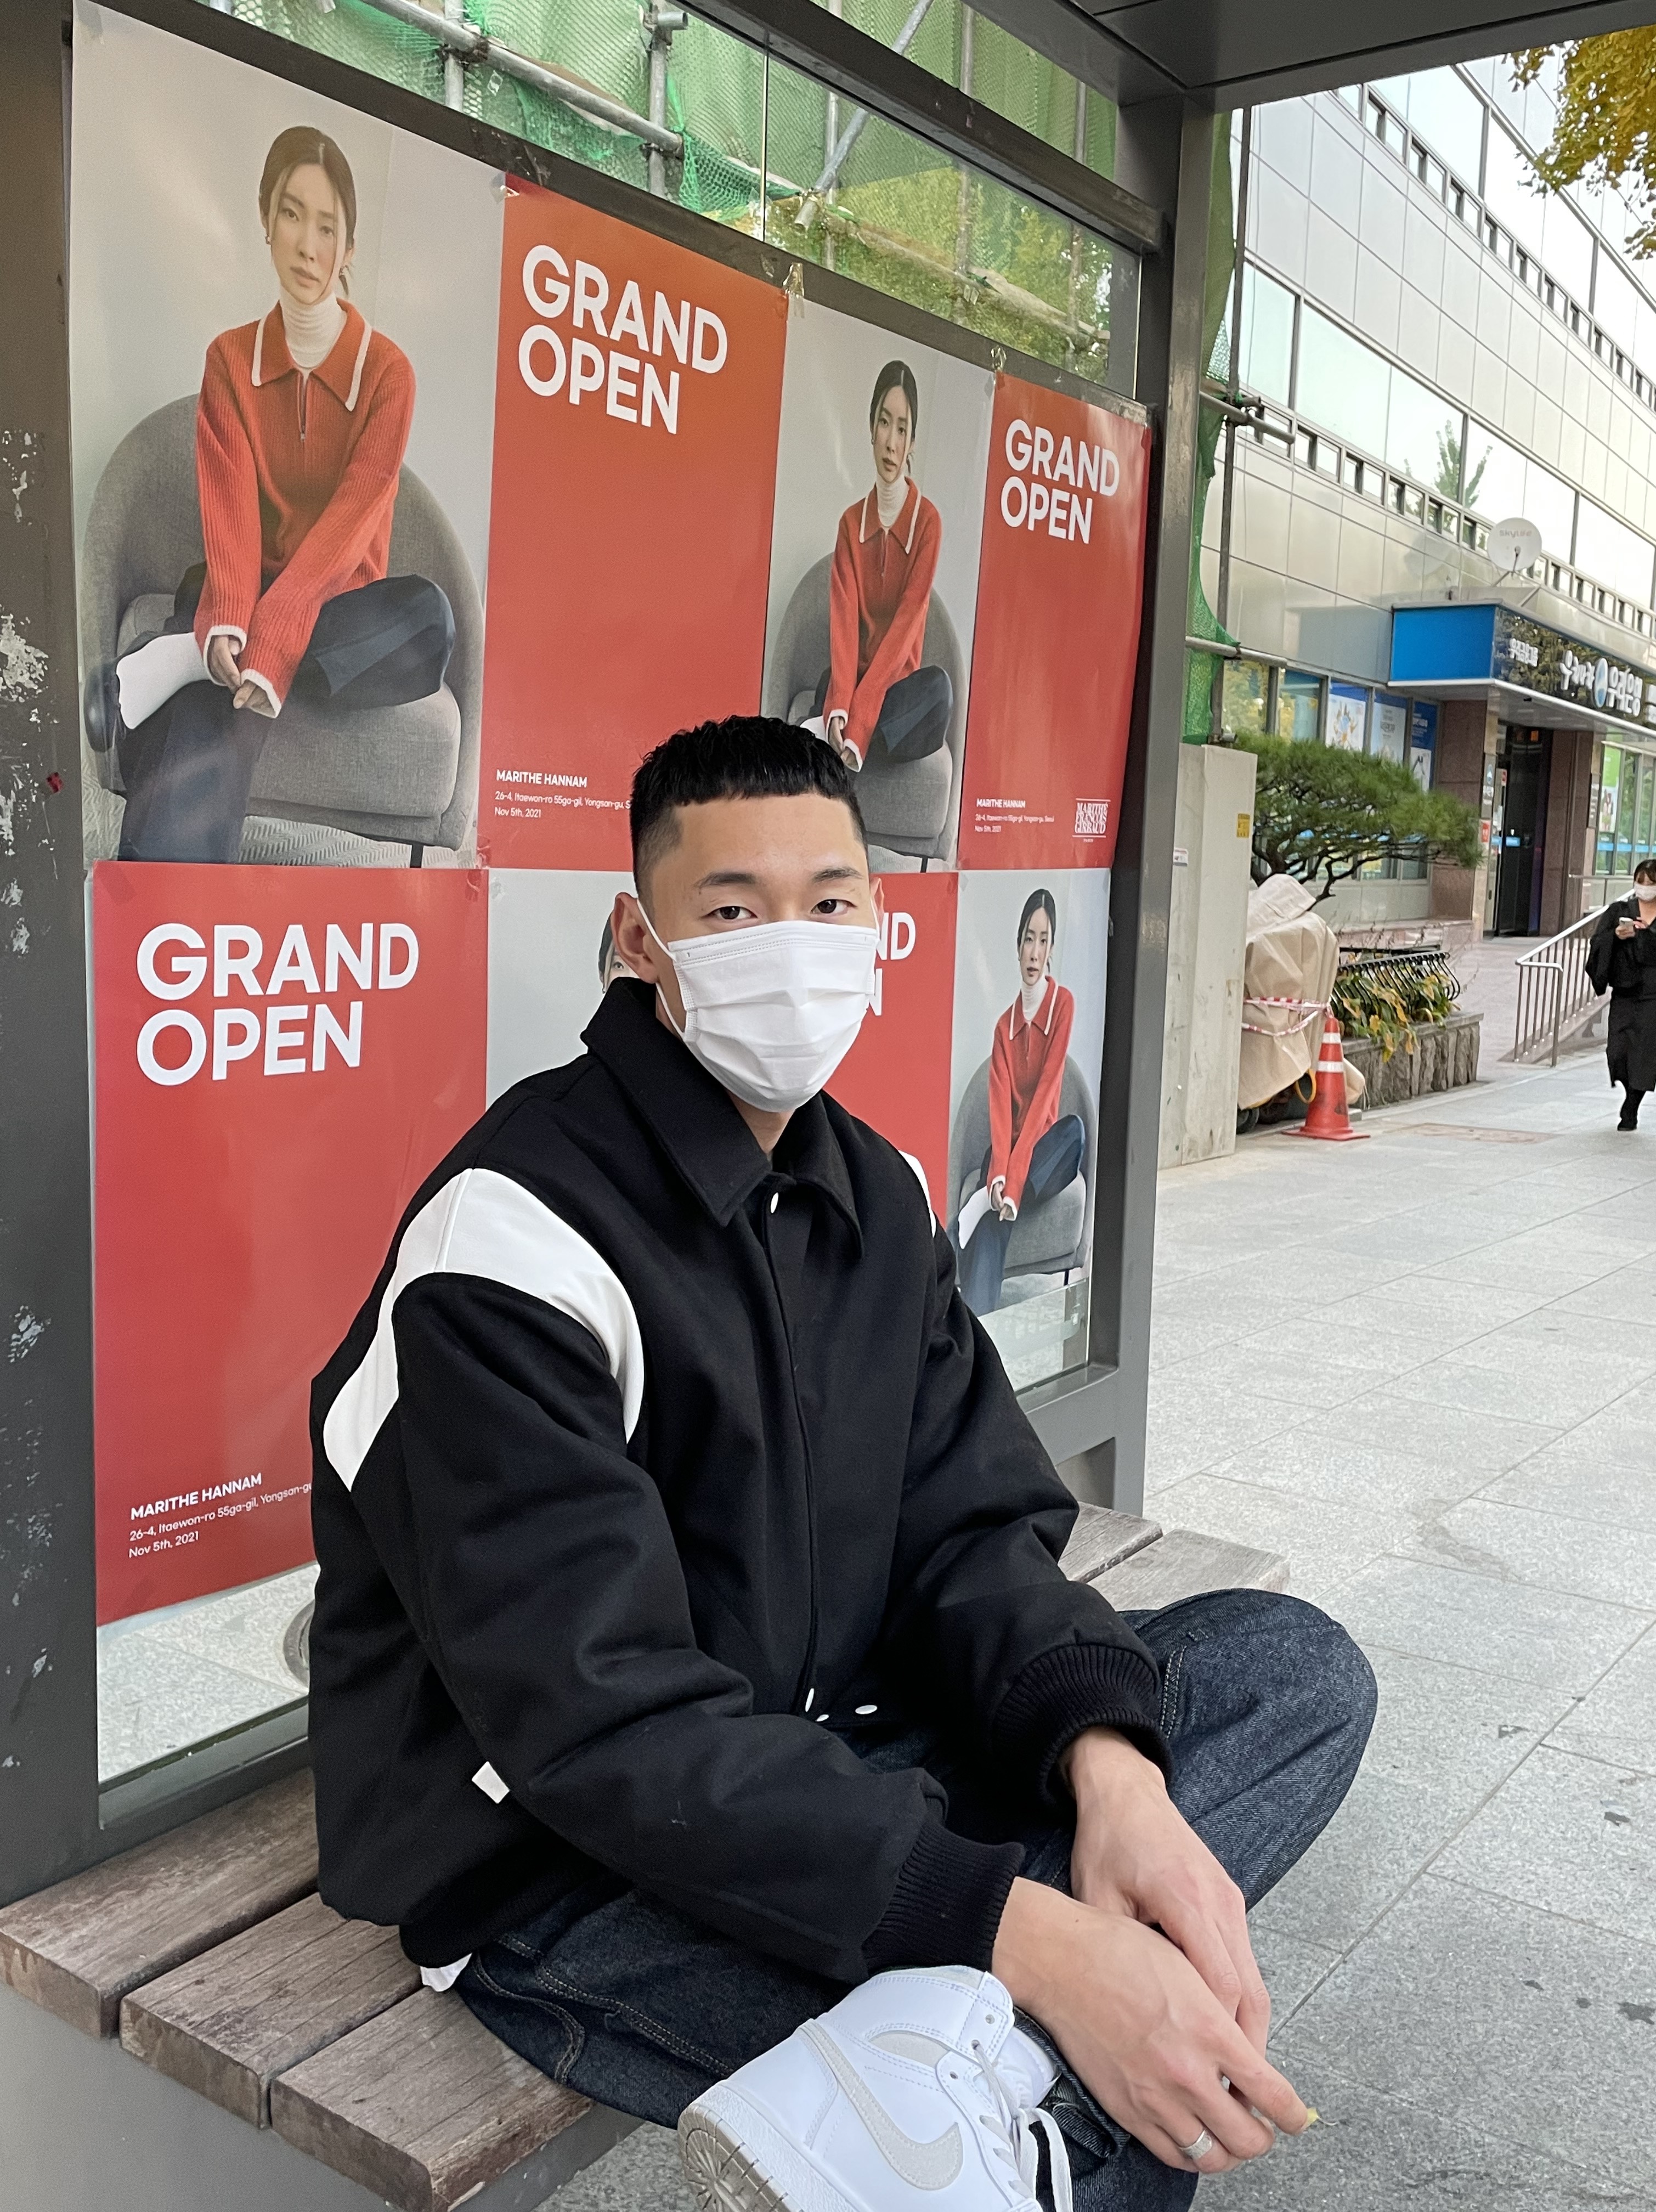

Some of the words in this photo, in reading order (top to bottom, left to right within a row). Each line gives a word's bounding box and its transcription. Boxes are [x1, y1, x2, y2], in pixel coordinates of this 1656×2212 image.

[522, 245, 728, 374] GRAND
[518, 324, 680, 435] OPEN
[1005, 419, 1120, 496] GRAND
[1001, 476, 1093, 544] OPEN
[495, 791, 513, 802] 26-4,
[515, 793, 553, 804] Itaewon-ro
[584, 797, 625, 810] Yongsan-gu,
[496, 769, 542, 784] MARITHE
[544, 772, 587, 788] HANNAM
[494, 806, 509, 817] Nov
[510, 808, 523, 818] 5th,
[525, 808, 541, 818] 2021
[976, 798, 1002, 808] MARITHE
[1003, 799, 1026, 808] HANNAM
[1075, 822, 1106, 834] GIRBAUD
[137, 923, 419, 1000] GRAND
[137, 1001, 363, 1086] OPEN
[131, 1491, 199, 1520] MARITHE
[201, 1472, 262, 1502] HANNAM
[129, 1526, 157, 1541] 26-4,
[158, 1511, 216, 1534] Itaewon-ro
[217, 1498, 259, 1517] 55ga-gil,
[128, 1545, 151, 1558] Nov
[152, 1539, 173, 1553] 5th,
[176, 1531, 199, 1546] 2021
